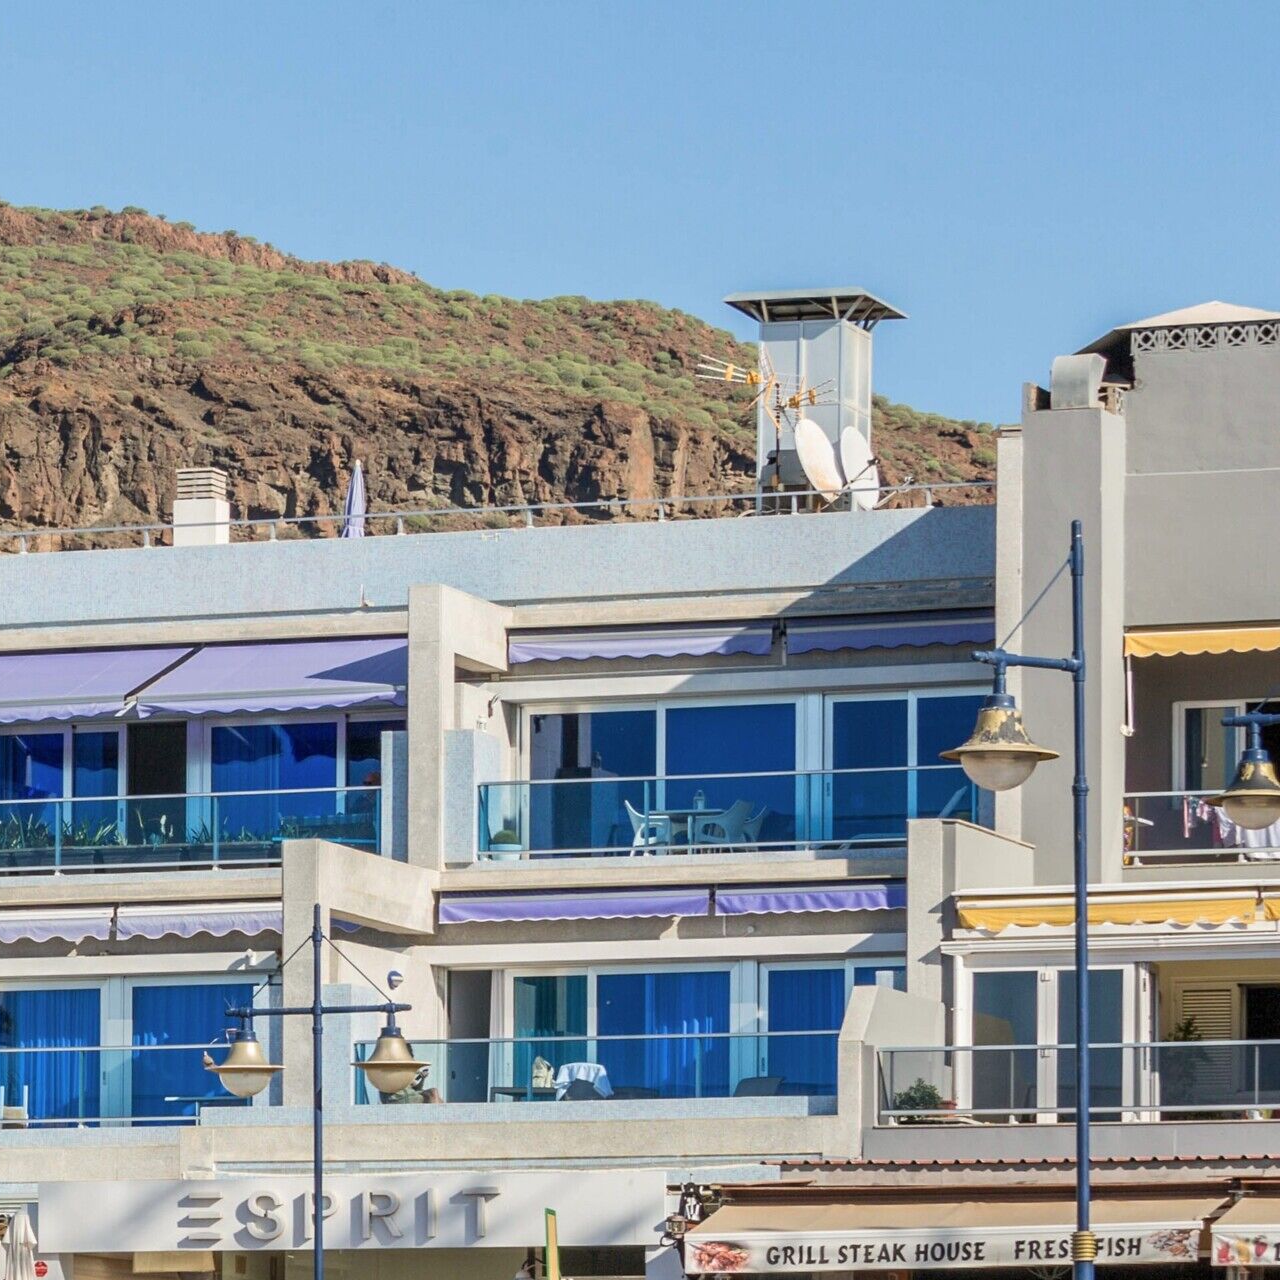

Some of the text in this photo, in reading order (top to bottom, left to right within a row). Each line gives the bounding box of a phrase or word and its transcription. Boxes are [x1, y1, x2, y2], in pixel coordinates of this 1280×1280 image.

[186, 1186, 502, 1241] ESPRIT
[766, 1245, 830, 1266] GRILL
[838, 1243, 907, 1264] STEAK
[914, 1241, 986, 1262] HOUSE
[1014, 1239, 1070, 1260] FRES
